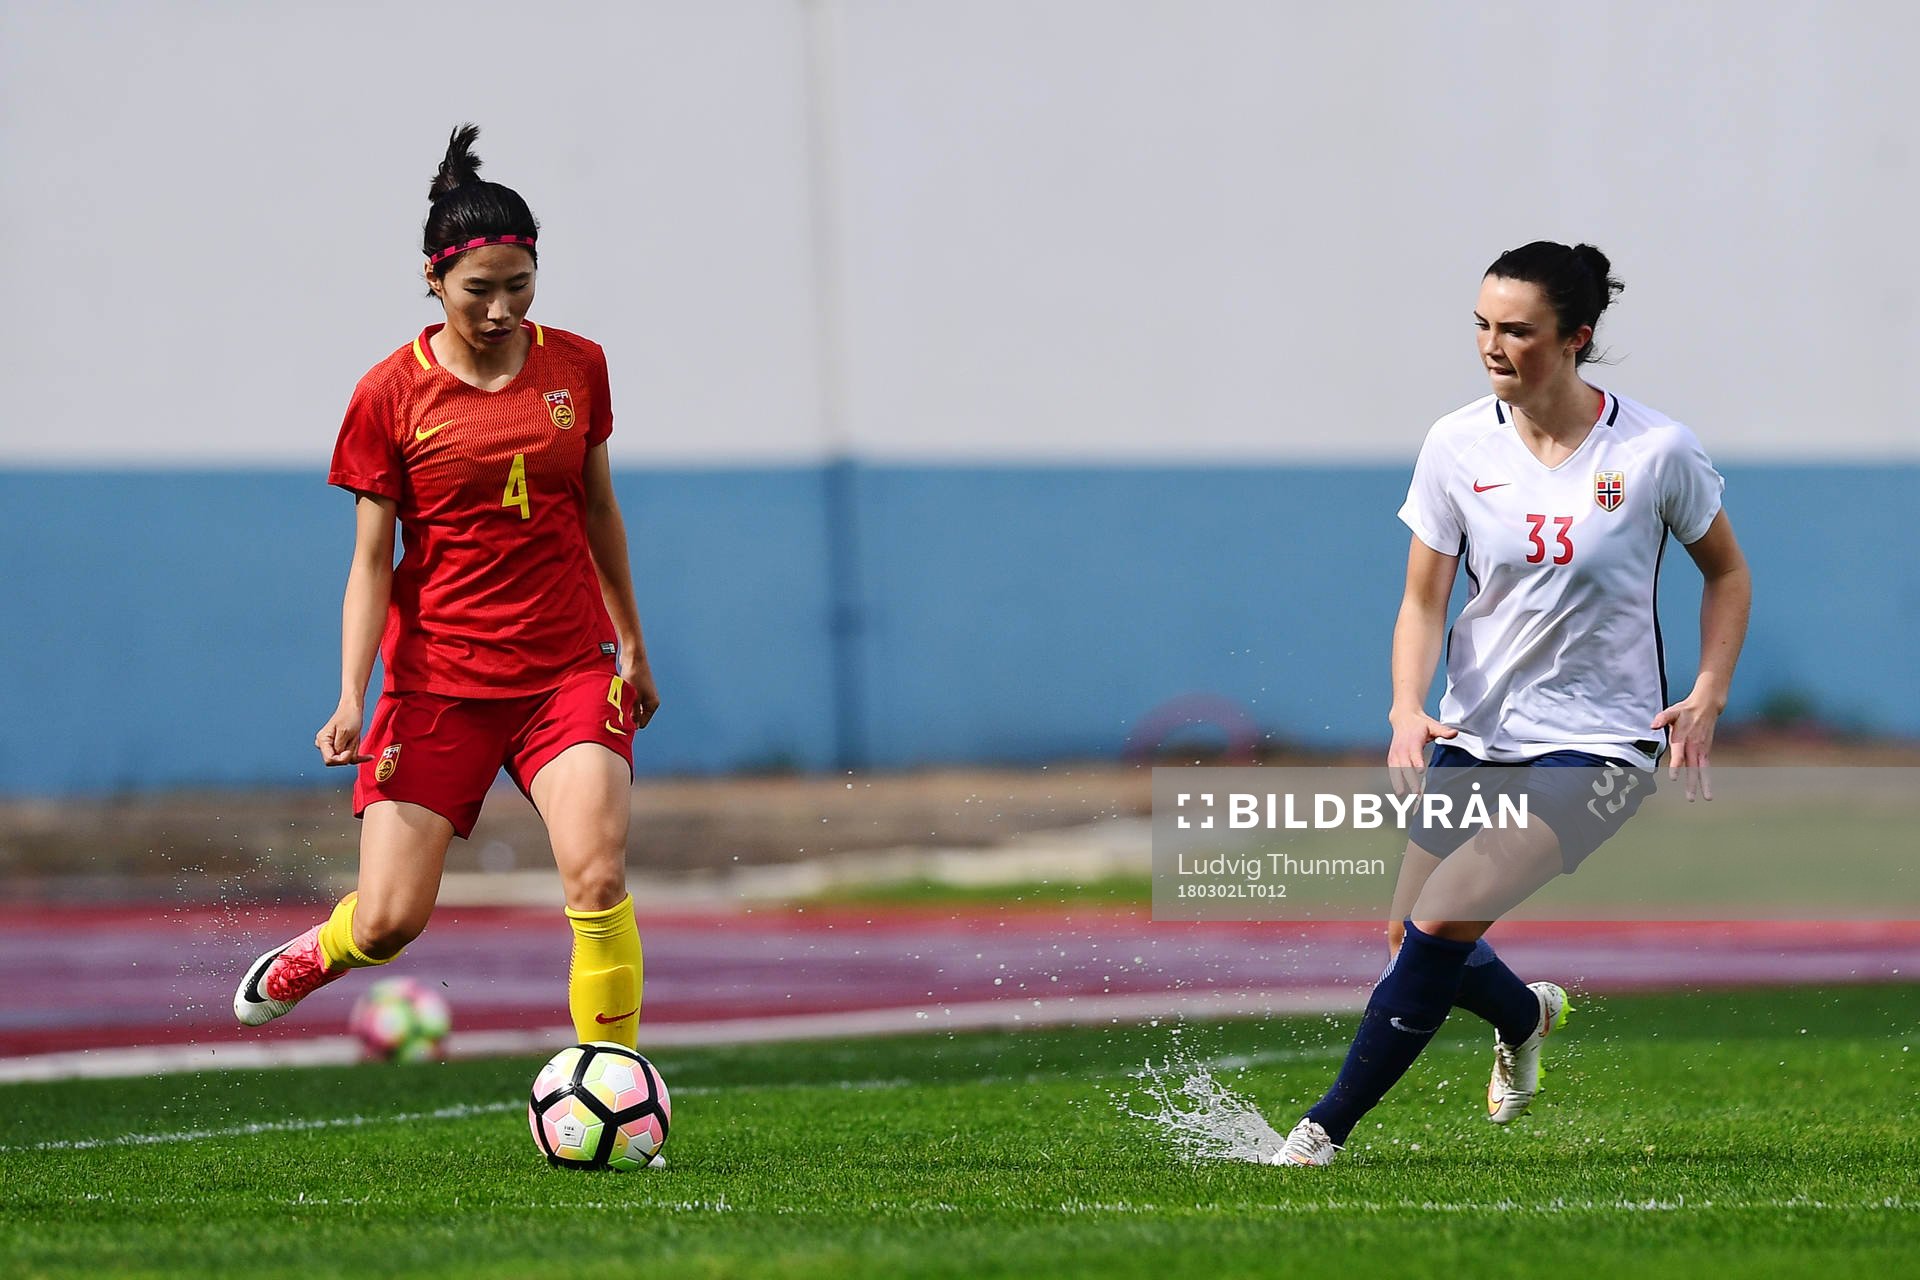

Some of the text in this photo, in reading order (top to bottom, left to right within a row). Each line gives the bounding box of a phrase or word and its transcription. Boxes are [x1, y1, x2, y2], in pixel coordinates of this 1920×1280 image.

[501, 453, 530, 519] 4
[1525, 513, 1574, 565] 33
[607, 675, 624, 726] 4
[1592, 761, 1639, 814] 33
